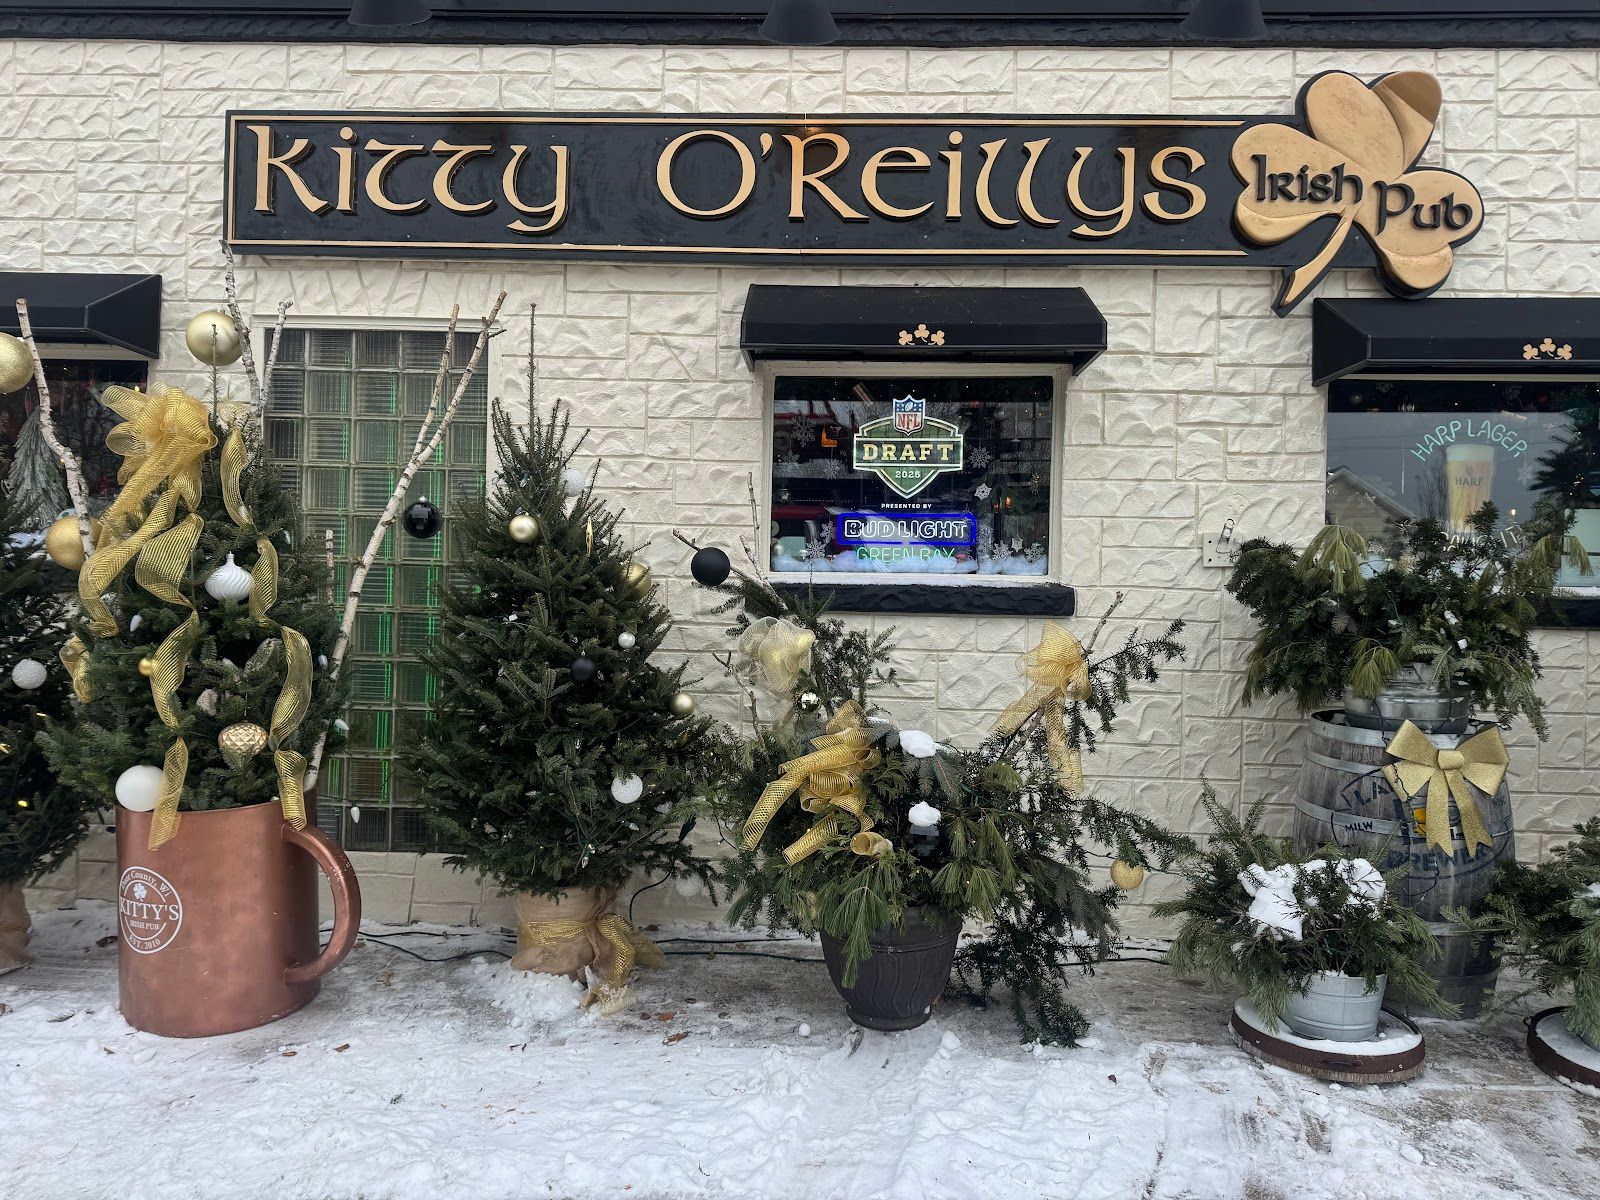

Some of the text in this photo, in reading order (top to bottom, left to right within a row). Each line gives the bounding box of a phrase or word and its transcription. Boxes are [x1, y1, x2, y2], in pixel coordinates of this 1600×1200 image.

[247, 125, 1207, 239] Kitty O'Reillys
[1251, 154, 1473, 236] Irish Pub
[896, 413, 922, 430] NFL
[1410, 419, 1529, 462] HARP LAGER
[863, 443, 954, 462] DRAFT
[895, 470, 921, 479] 2025
[1455, 476, 1484, 487] HARP
[844, 519, 968, 539] BUD LIGHT
[856, 547, 915, 562] GREEN
[119, 896, 180, 921] KITTY'S
[145, 922, 160, 931] PUB
